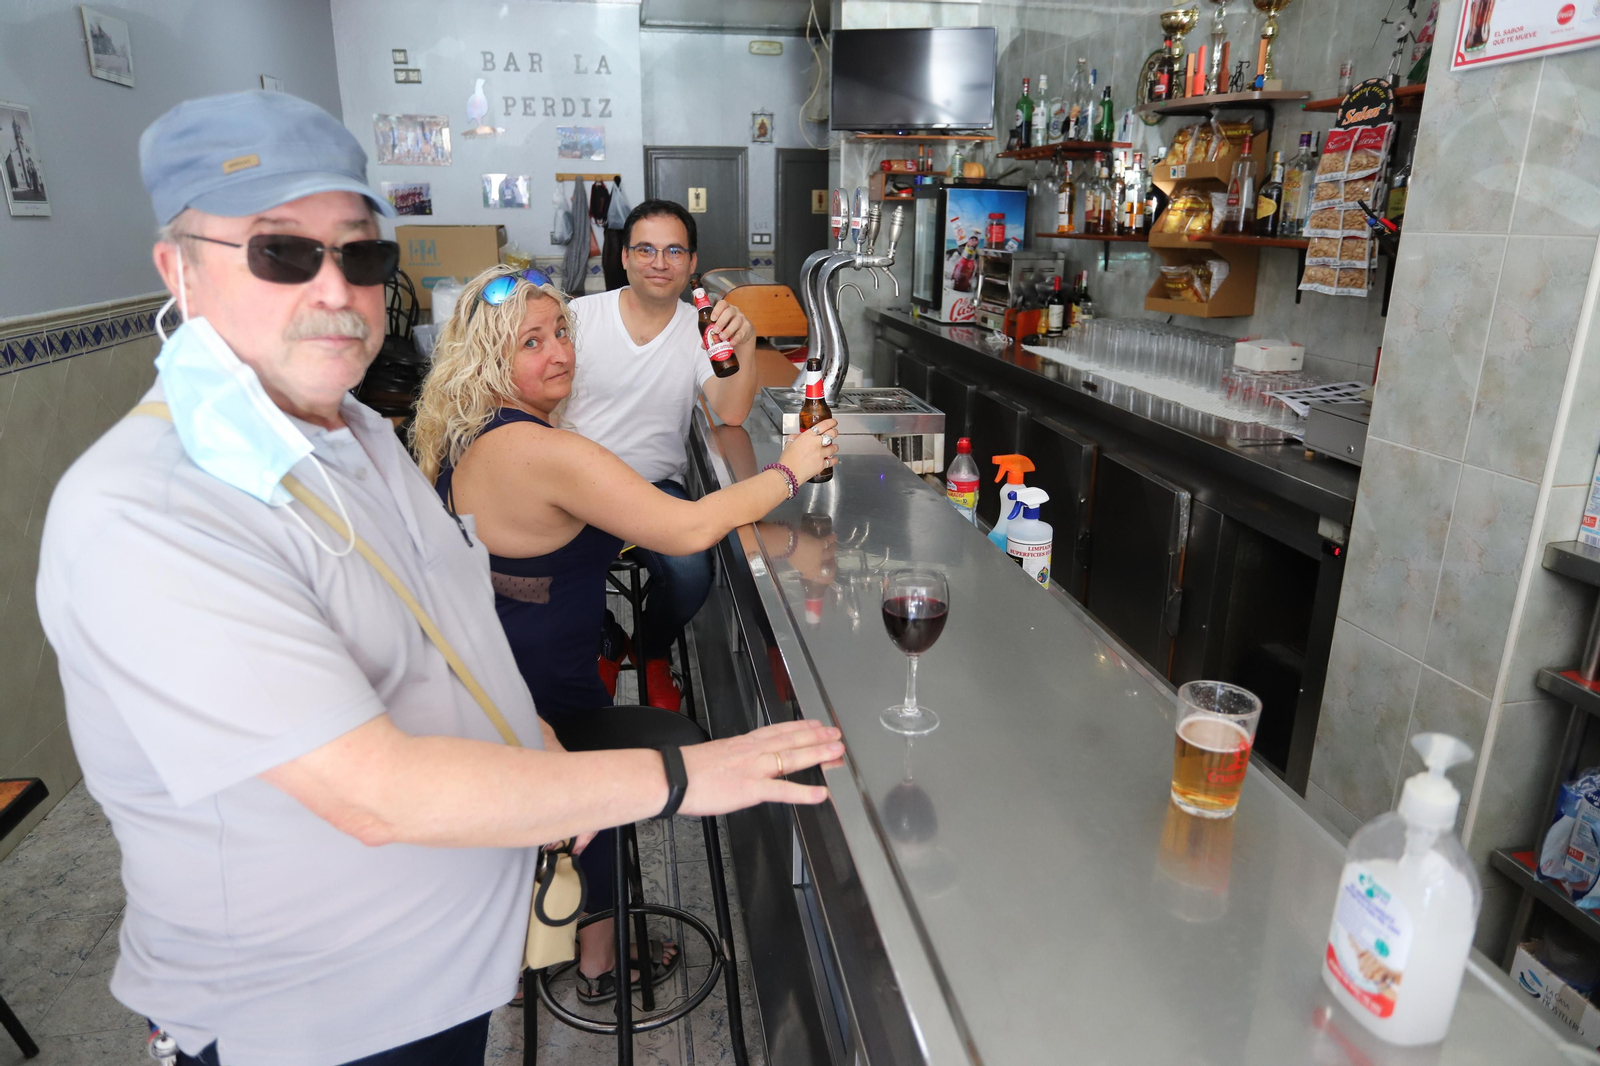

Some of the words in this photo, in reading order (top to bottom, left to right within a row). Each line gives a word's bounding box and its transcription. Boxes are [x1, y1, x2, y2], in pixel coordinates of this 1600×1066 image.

[1503, 26, 1524, 35] SABOR
[1492, 38, 1505, 46] QUE
[1515, 31, 1538, 41] MUEVE
[481, 51, 543, 73] BAR
[574, 53, 612, 75] LA
[1371, 86, 1386, 99] SECOS
[502, 96, 613, 118] PERDIZ
[1341, 105, 1381, 126] Salen
[754, 222, 769, 230] LUZ
[1010, 549, 1046, 558] SUPERFICIES
[1554, 992, 1570, 1010] CASA
